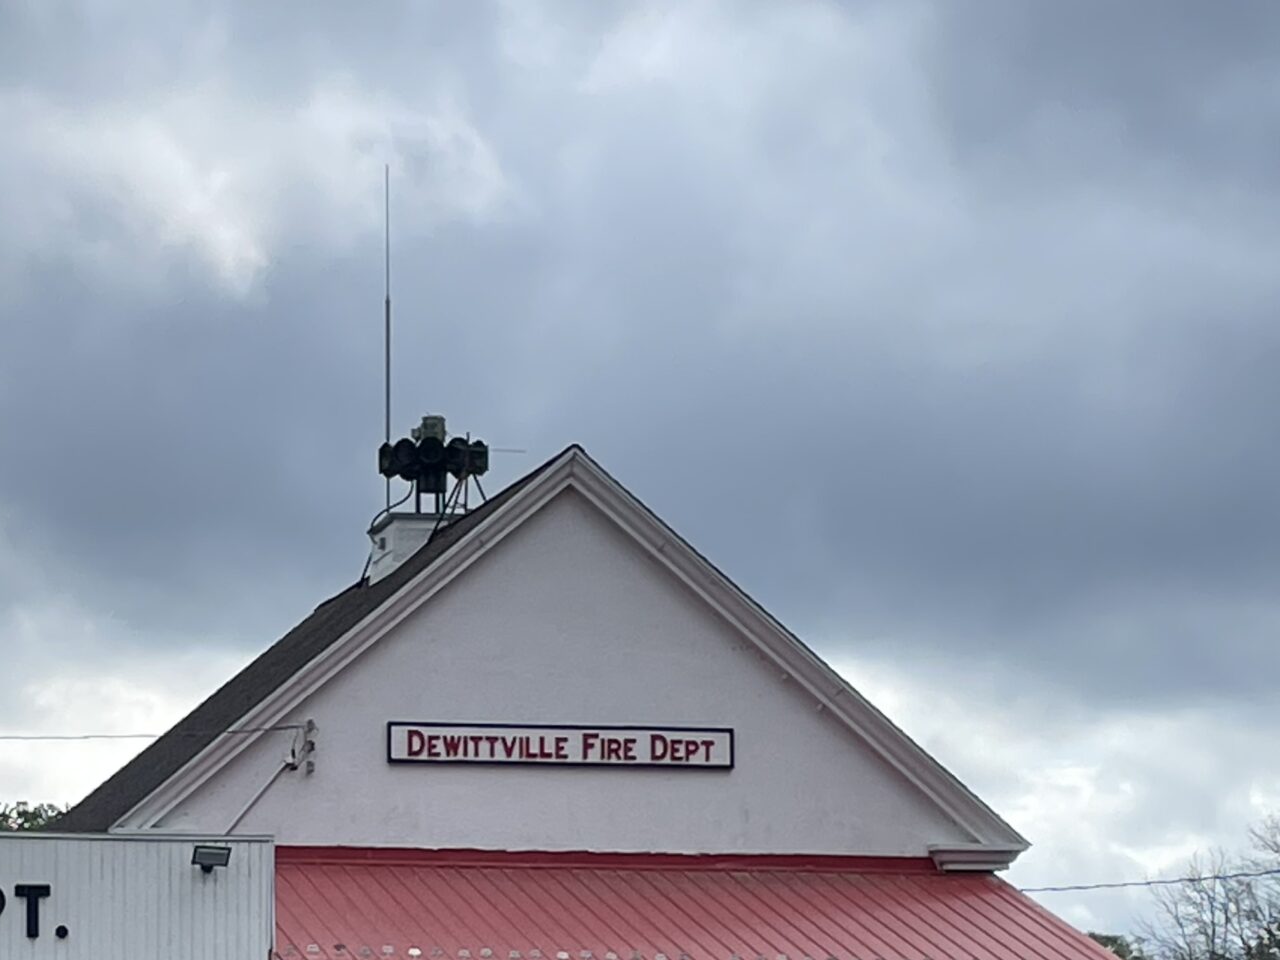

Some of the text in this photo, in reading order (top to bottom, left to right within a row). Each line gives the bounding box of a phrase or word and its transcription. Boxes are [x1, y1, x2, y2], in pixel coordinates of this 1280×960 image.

[406, 729, 715, 762] DEWITTVILLE FIRE DEPT
